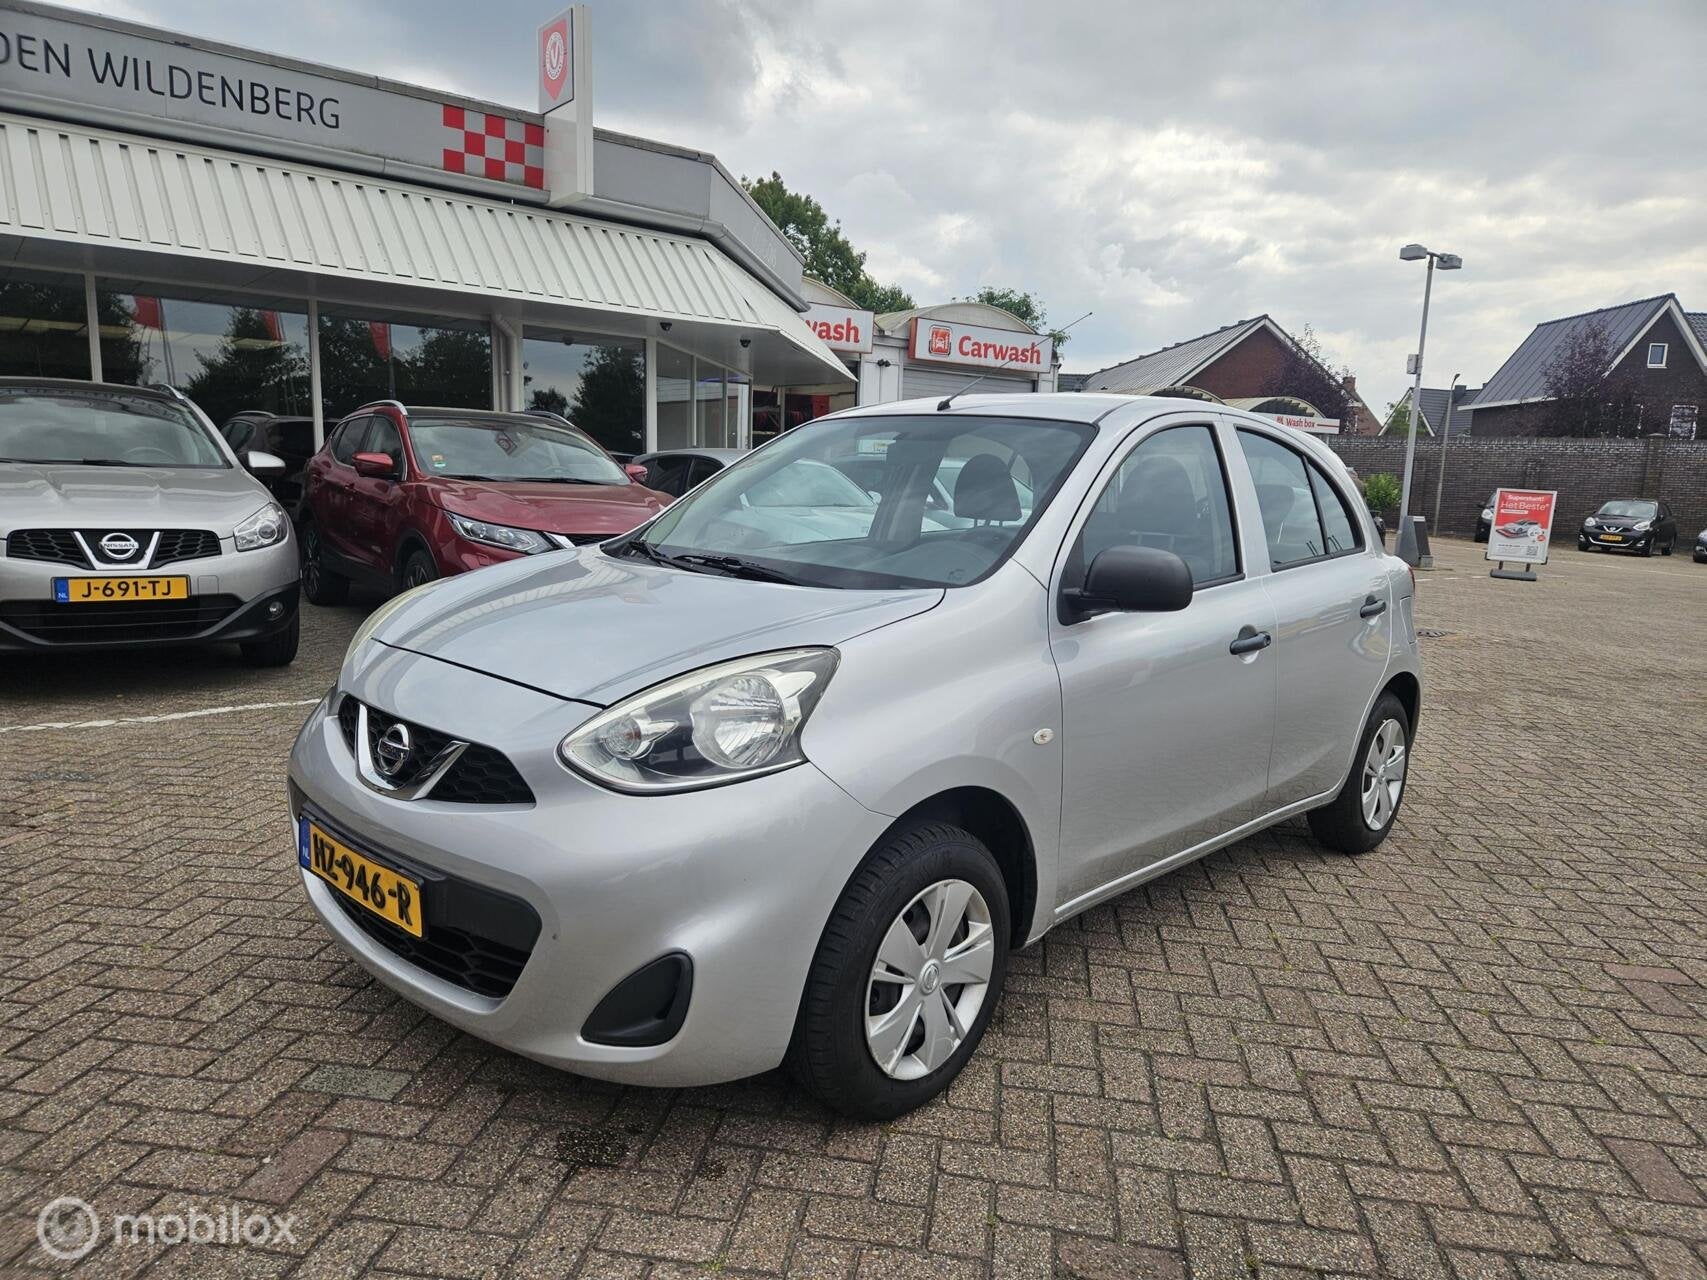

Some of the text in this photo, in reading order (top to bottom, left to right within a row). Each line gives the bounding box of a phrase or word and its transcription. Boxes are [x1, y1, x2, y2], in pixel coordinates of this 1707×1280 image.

[87, 47, 340, 130] WILDENBERG
[958, 335, 1041, 365] Carwash
[1286, 417, 1315, 428] Wash box
[1500, 500, 1518, 509] Het
[81, 580, 172, 598] J-691-TJ
[312, 833, 413, 927] HZ-946-R
